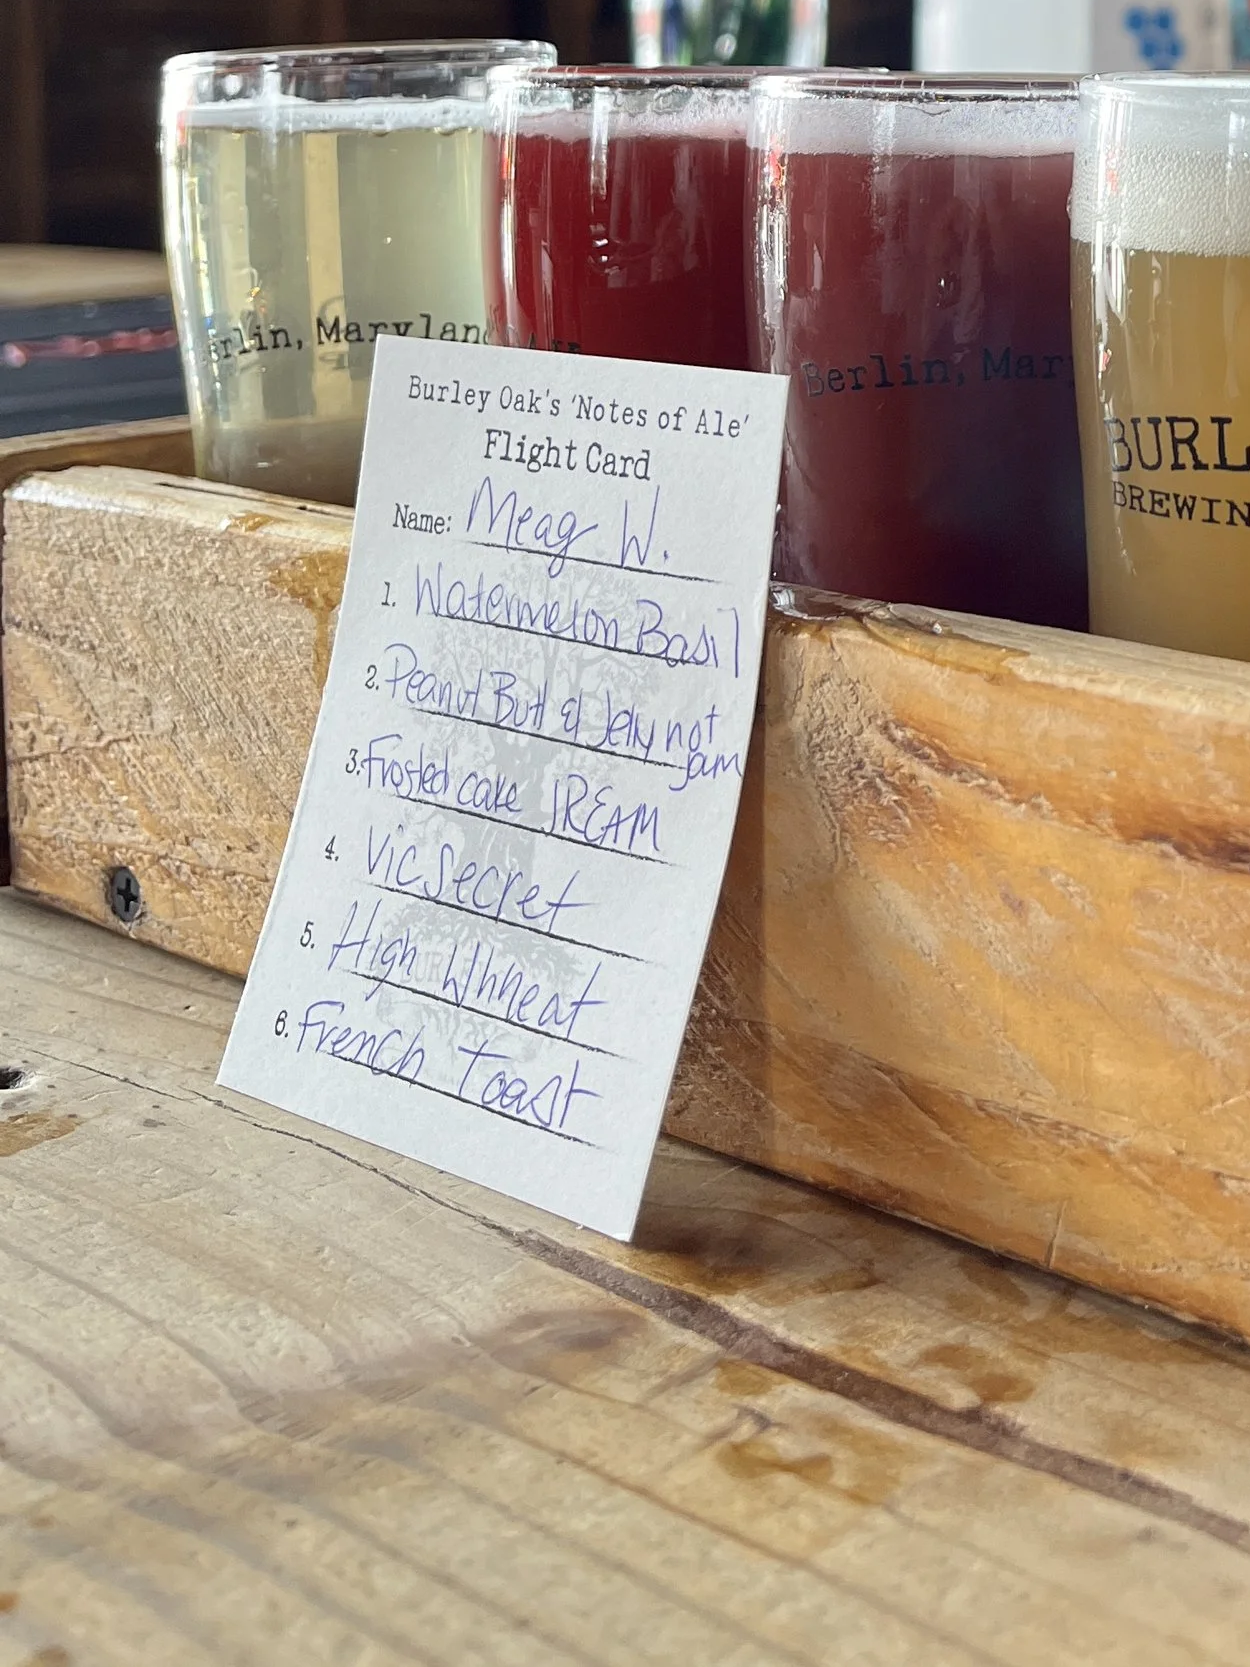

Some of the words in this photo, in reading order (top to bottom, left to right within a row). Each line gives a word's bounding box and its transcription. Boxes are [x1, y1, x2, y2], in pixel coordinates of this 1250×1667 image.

[409, 374, 491, 413] Burley
[499, 385, 561, 417] Oak's
[571, 394, 648, 428] 'Notes
[658, 406, 688, 432] of
[695, 409, 750, 439] Ale'
[802, 353, 966, 398] Berlin,
[483, 428, 578, 473] Flight
[586, 441, 652, 481] Card
[392, 502, 453, 535] Name:
[466, 475, 599, 579] Meag
[619, 484, 670, 567] W.
[381, 581, 397, 607] 1.
[415, 562, 619, 650] Watermelon
[635, 598, 739, 679] Basil
[365, 664, 380, 691] 2.
[384, 643, 482, 717] Peanut
[585, 689, 656, 760] Jelly
[665, 704, 721, 753] not
[345, 748, 360, 776] 3.
[360, 733, 450, 799] Frosted
[668, 750, 741, 791] jam
[324, 835, 339, 862] 4.
[299, 921, 315, 949] 5.
[327, 898, 417, 1002] High
[274, 1009, 289, 1038] 6.
[296, 1000, 425, 1087] French
